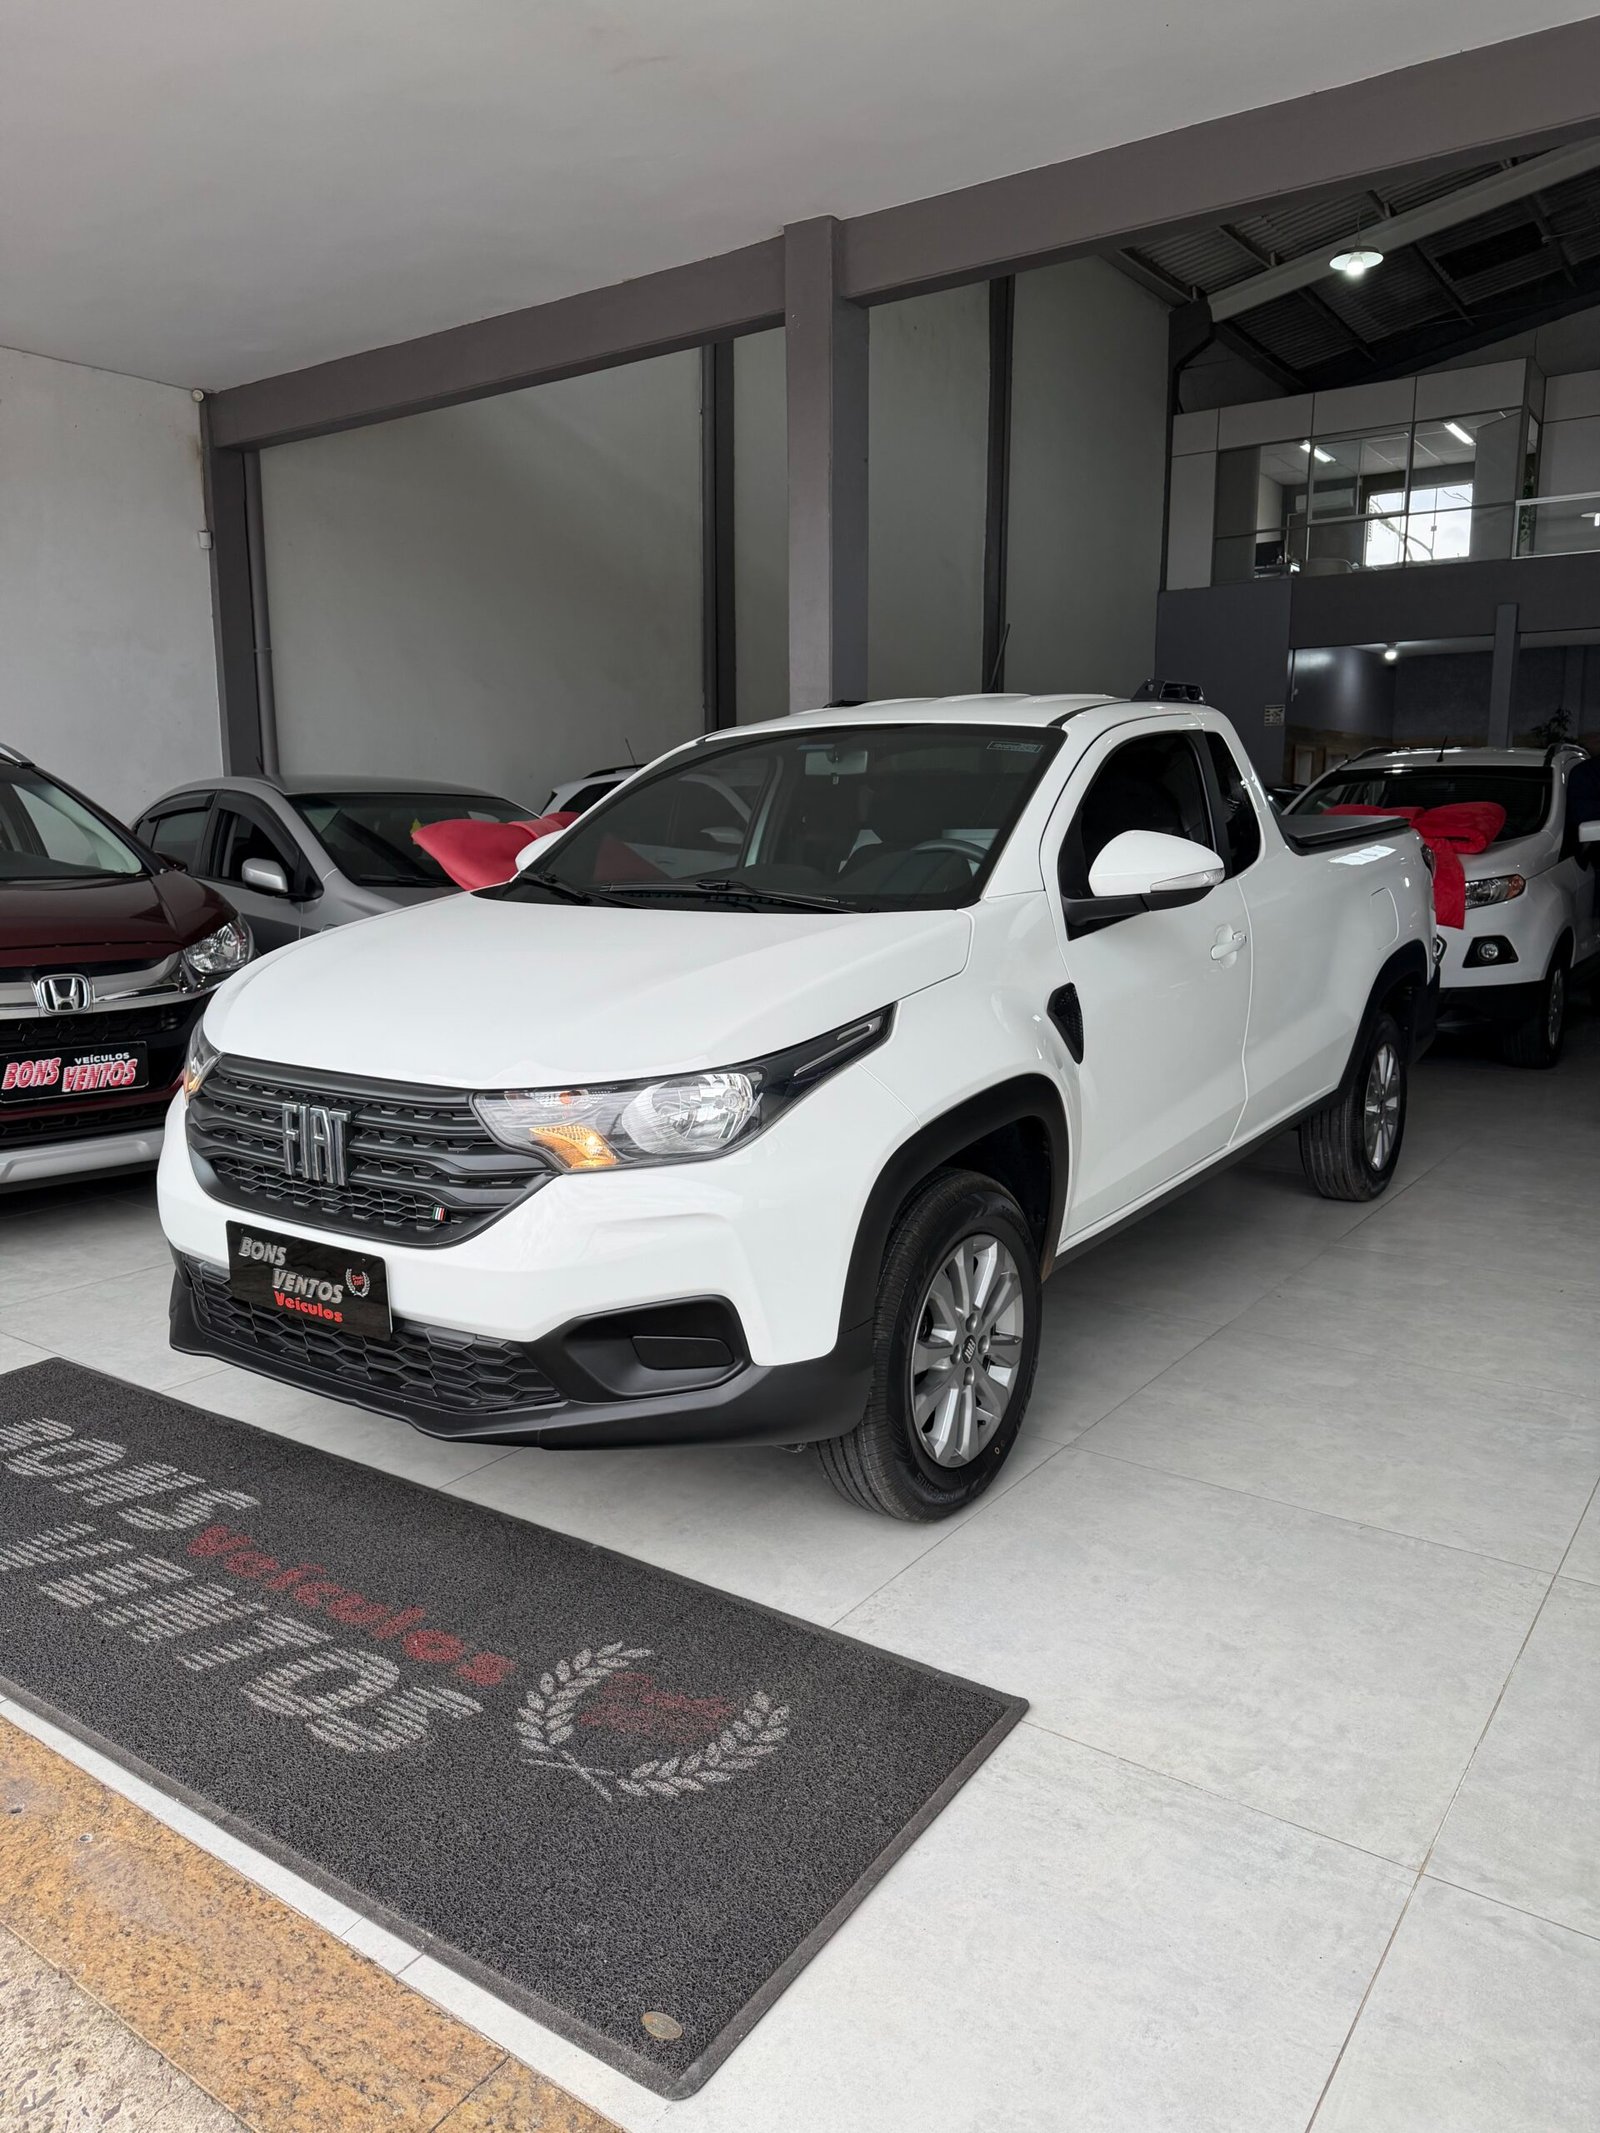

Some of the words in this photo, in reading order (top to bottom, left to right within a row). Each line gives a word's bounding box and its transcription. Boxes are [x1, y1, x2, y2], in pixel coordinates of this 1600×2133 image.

[1, 1057, 62, 1090] BONS
[61, 1058, 138, 1092] VENTOS
[74, 1052, 130, 1065] VEÍCULOS
[281, 1100, 351, 1187] FIAT
[238, 1236, 287, 1266] BONS
[272, 1267, 344, 1304] VENTOS
[274, 1290, 343, 1323] Veículos
[964, 1338, 976, 1362] FIAT
[186, 1523, 517, 1687] Veículos
